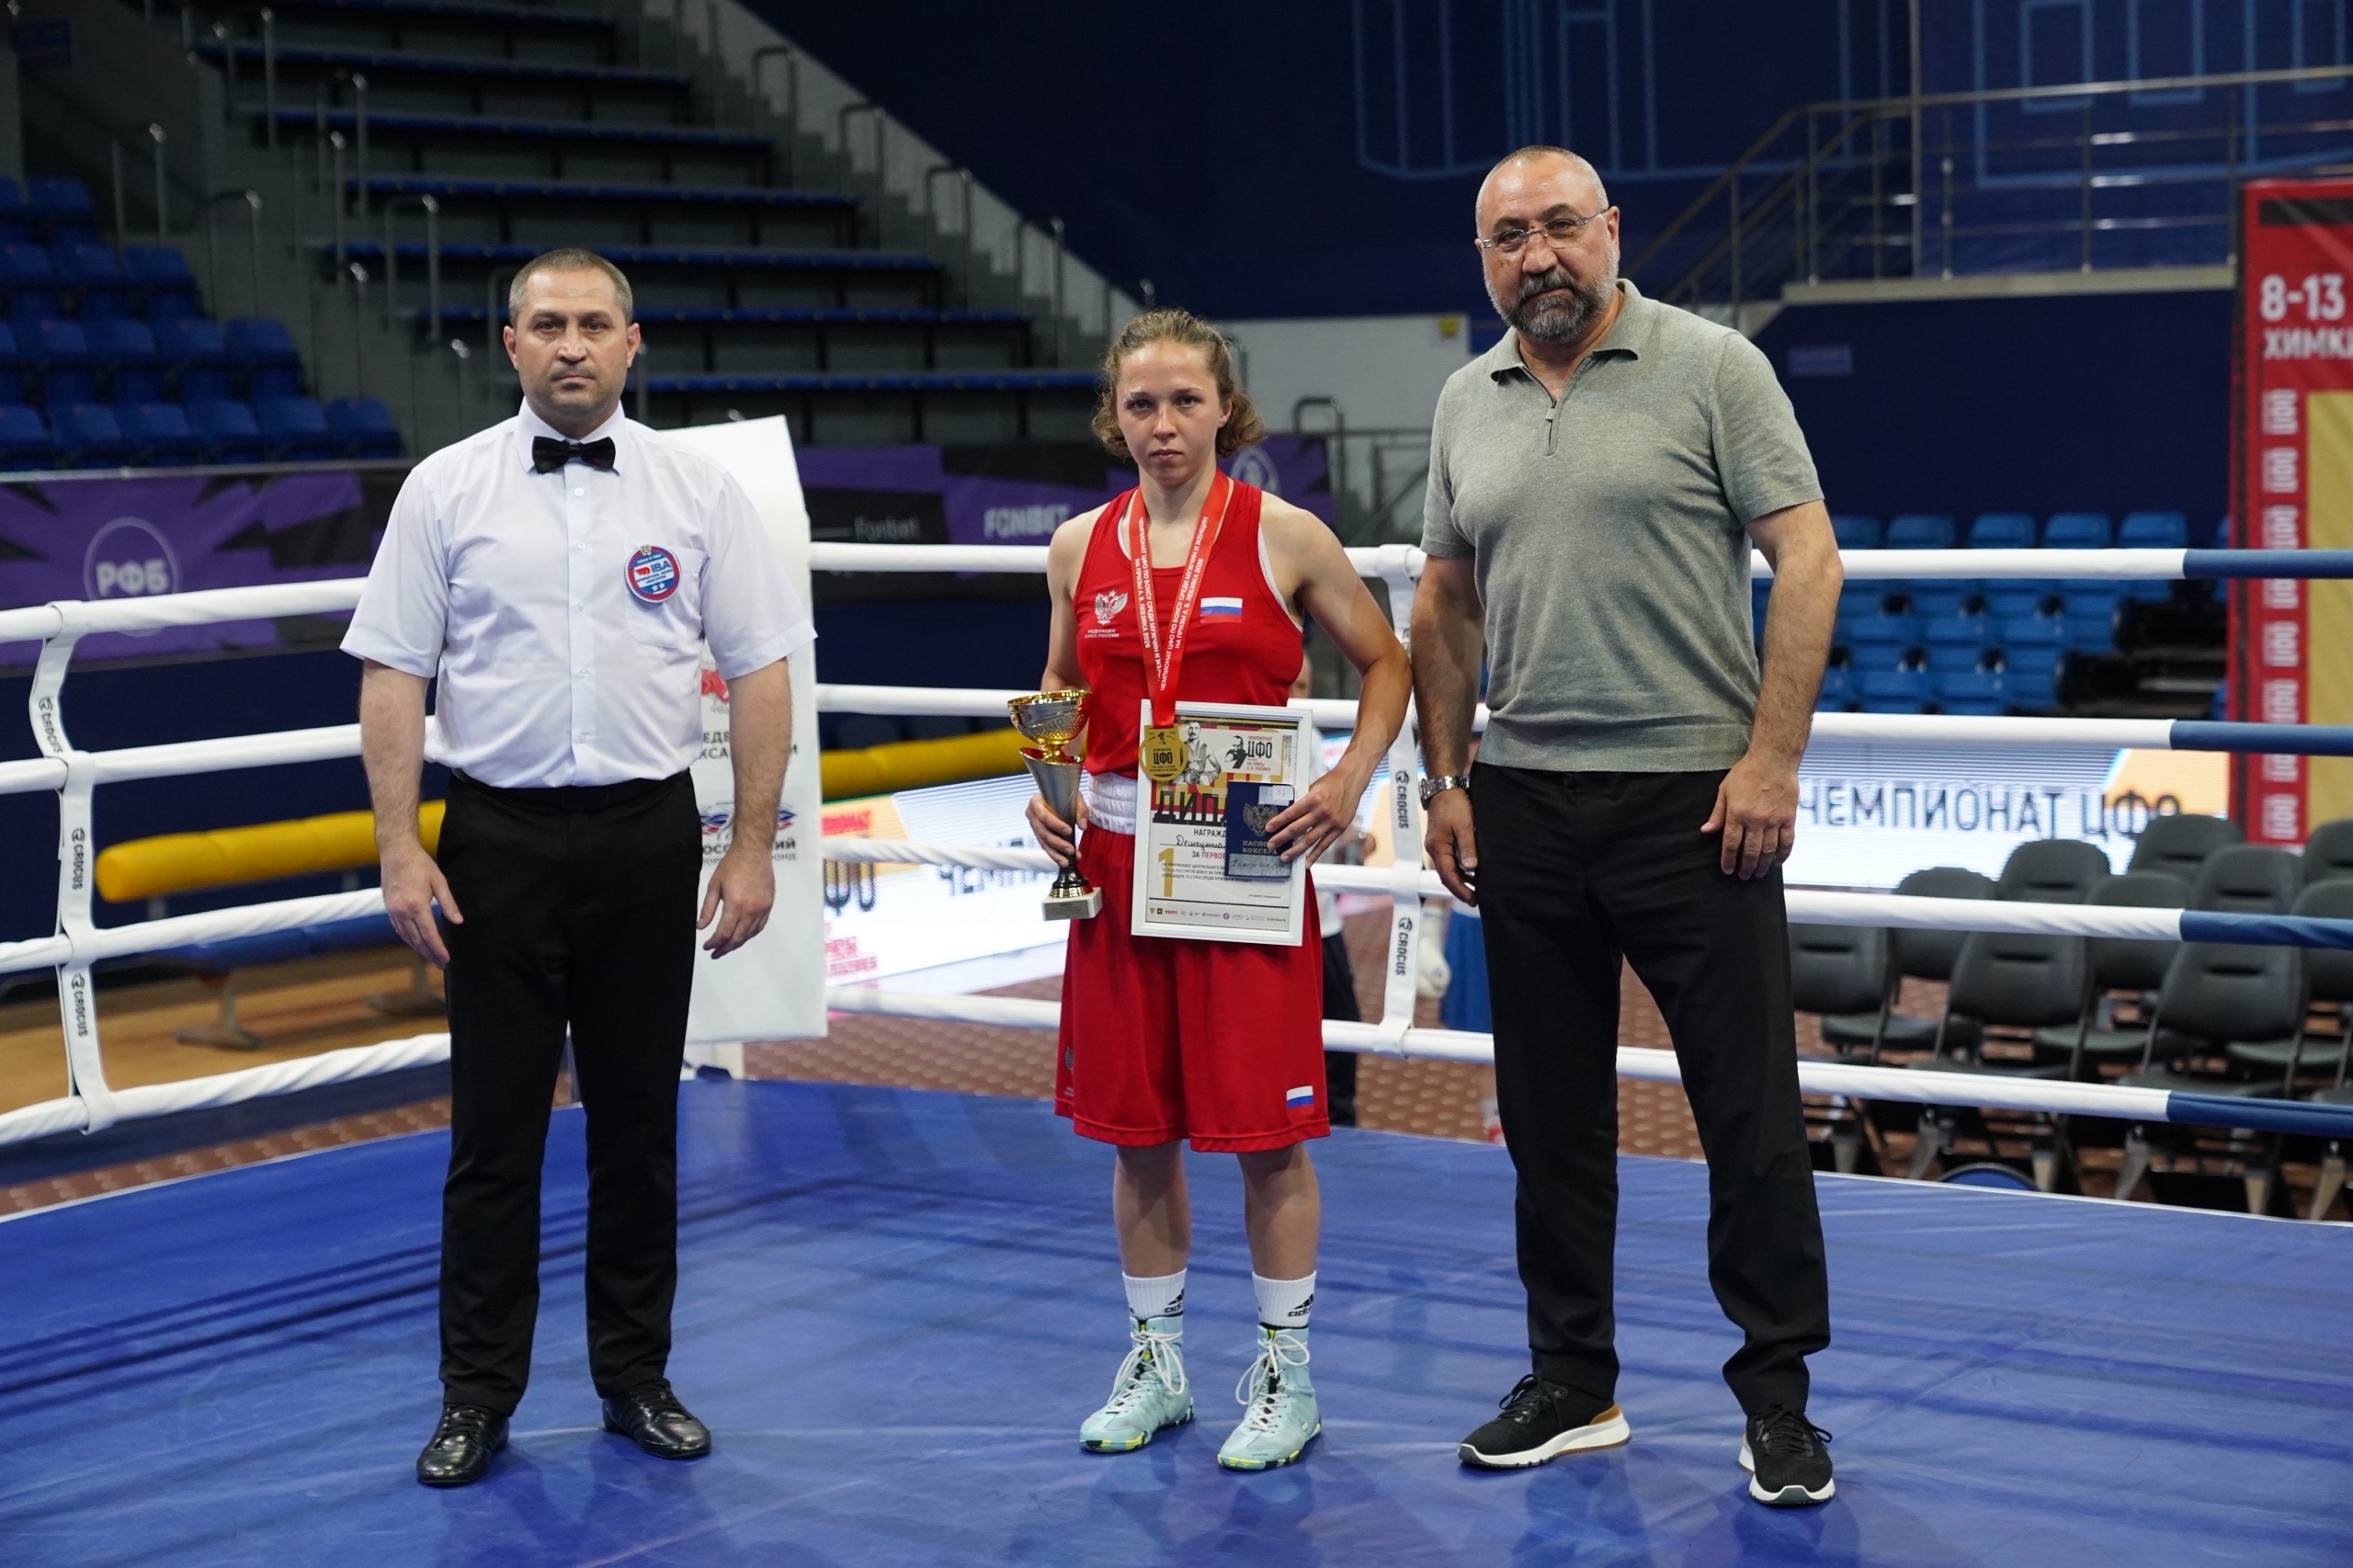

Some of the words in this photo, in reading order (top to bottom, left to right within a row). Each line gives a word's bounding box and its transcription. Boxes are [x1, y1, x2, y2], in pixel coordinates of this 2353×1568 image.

[2259, 273, 2346, 322] 8-13
[2263, 327, 2353, 359] ХИМК
[1195, 517, 1208, 545] ЖЕНЩИН
[651, 560, 671, 574] IBA
[1135, 558, 1141, 568] НА
[1185, 551, 1198, 580] МУЖЧИН
[96, 560, 169, 597] РФБ
[1139, 517, 1147, 553] ЧЕМПИОНАТ
[1143, 570, 1149, 579] ПО
[1146, 601, 1154, 622] СРЕДИ
[1150, 622, 1158, 652] МУЖЧИН
[1178, 580, 1189, 601] СРЕДИ
[1186, 574, 1199, 601] ЛЕБЗЯКА
[1173, 601, 1182, 623] БОКСУ
[1170, 623, 1177, 633] ПО
[1176, 615, 1187, 638] ПРИЗЫ
[1175, 639, 1181, 649] НА
[1161, 651, 1171, 690] ЧЕМПИОНАТ
[1153, 751, 1174, 765] ЦФО
[1247, 740, 1273, 759] ЦФО
[1152, 790, 1227, 827] ДИП
[1395, 785, 1410, 829] CROCUS
[1799, 784, 2063, 839] ЧЕМПИОНАТ
[2082, 789, 2181, 842] ЦФО
[1193, 828, 1227, 837] НАГРАЖД
[1157, 847, 1175, 897] 1
[1394, 933, 1407, 976] CROCUS
